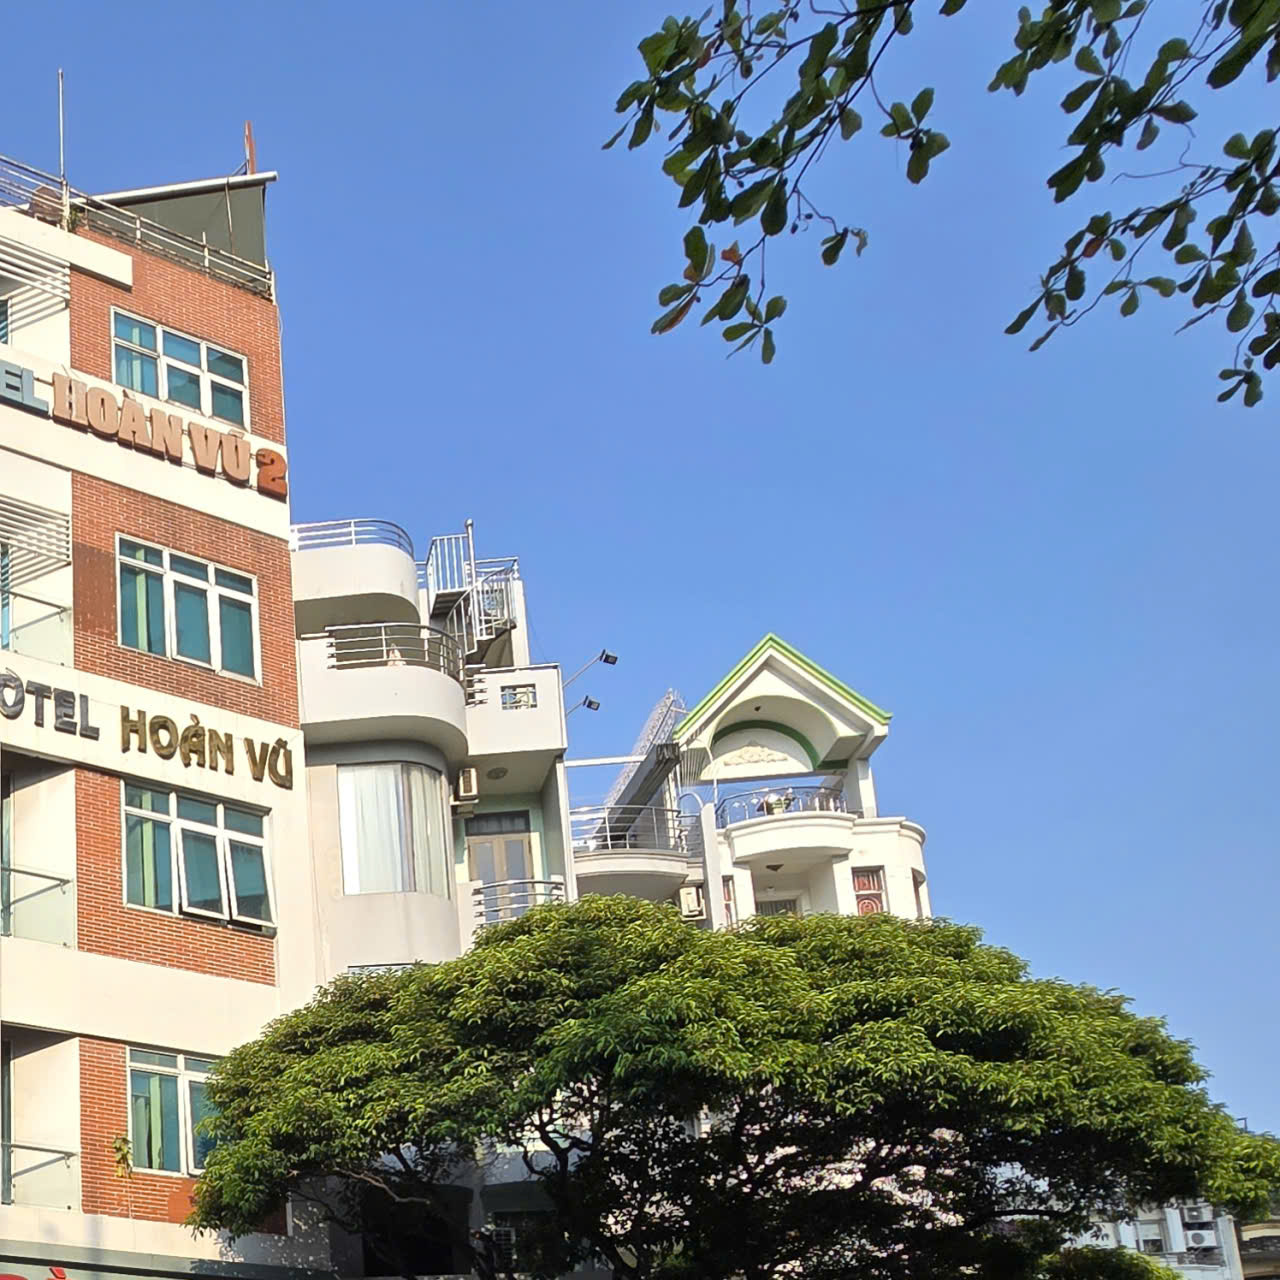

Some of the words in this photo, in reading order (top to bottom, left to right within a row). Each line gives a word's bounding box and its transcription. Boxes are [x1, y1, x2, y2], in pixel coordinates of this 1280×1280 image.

[52, 371, 183, 467] HOÀN
[187, 420, 251, 488] VŨ
[256, 448, 288, 499] 2
[120, 704, 234, 776] HOÀN
[244, 736, 293, 790] VŨ
